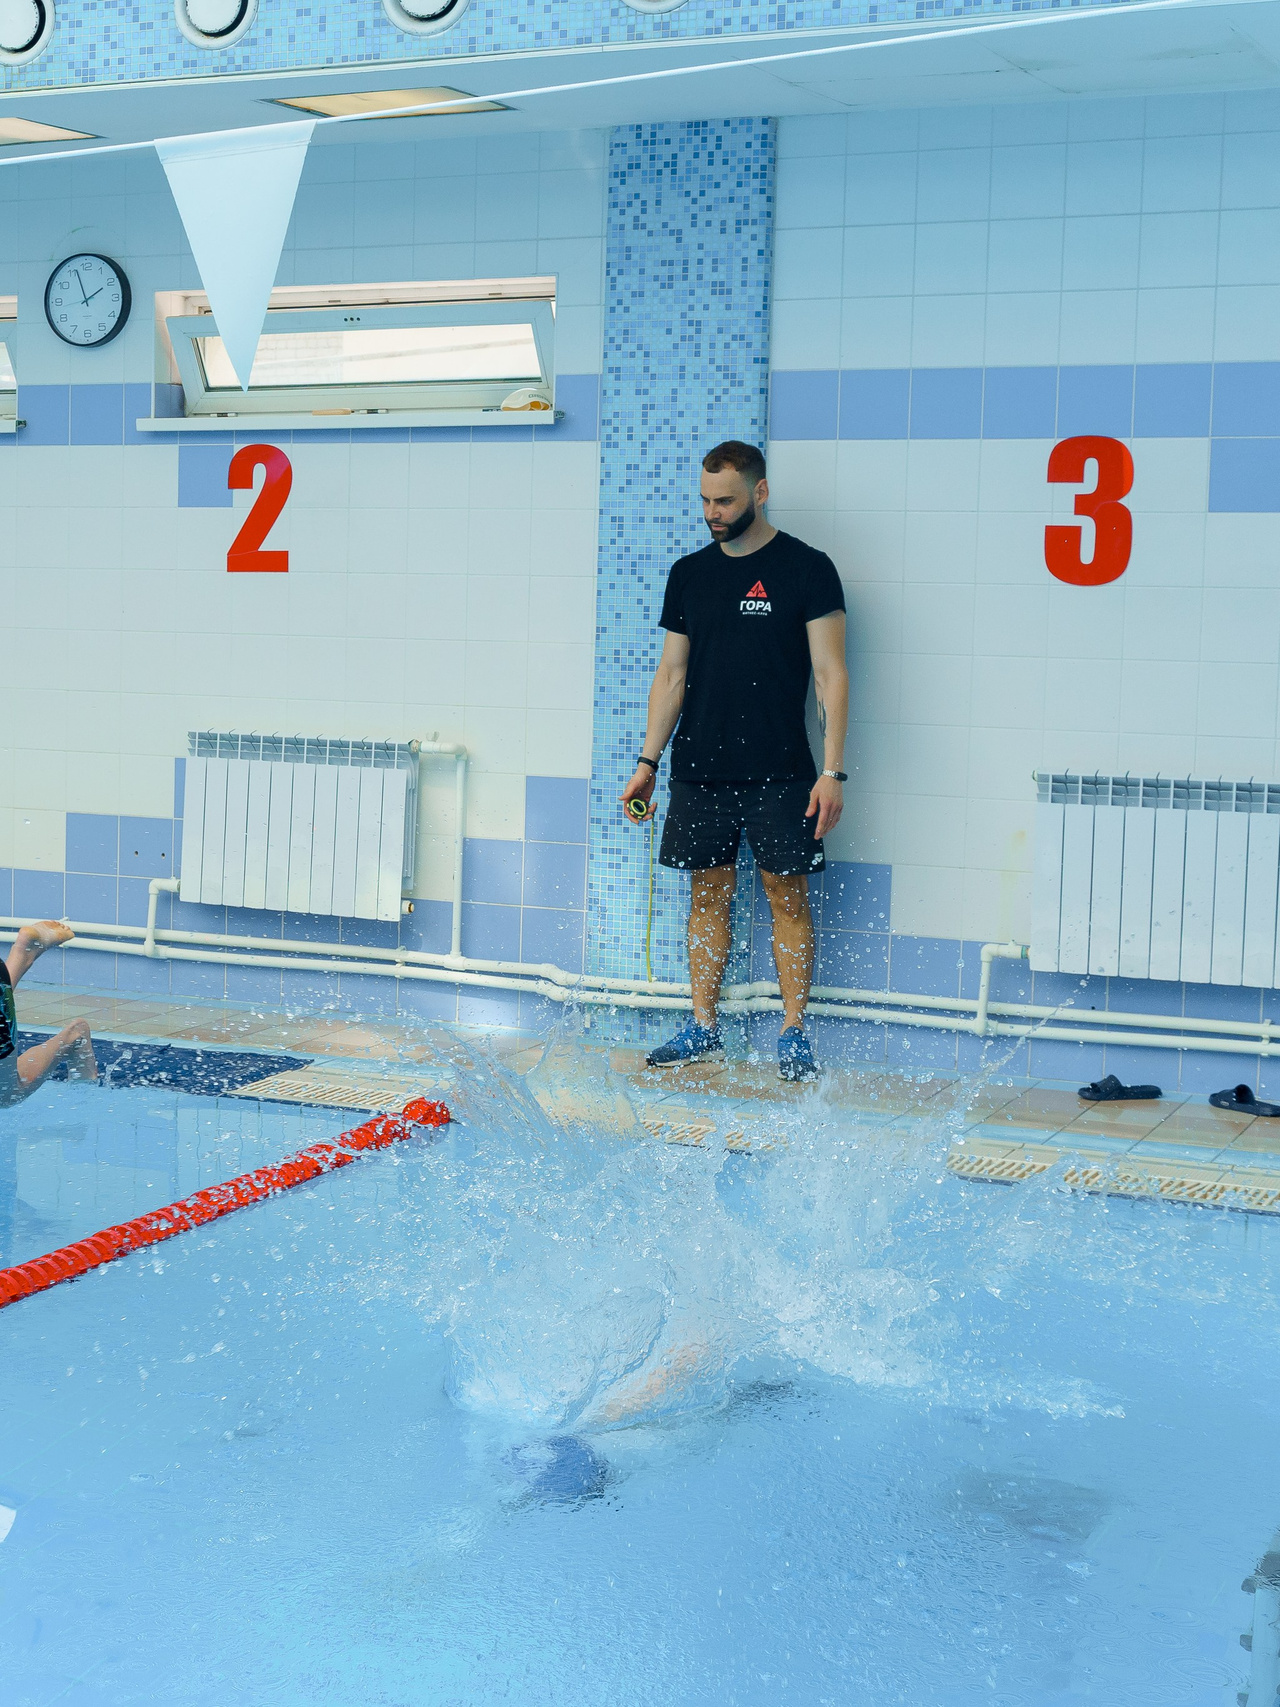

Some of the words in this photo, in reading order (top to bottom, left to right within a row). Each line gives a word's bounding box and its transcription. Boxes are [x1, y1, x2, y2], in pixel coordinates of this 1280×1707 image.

[80, 262, 92, 271] 12
[67, 269, 77, 277] 11
[58, 281, 69, 290] 10
[106, 277, 115, 286] 2
[54, 297, 63, 306] 9
[111, 293, 120, 302] 3
[59, 313, 68, 322] 8
[107, 310, 116, 318] 4
[70, 324, 78, 334] 7
[98, 322, 107, 331] 5
[83, 329, 92, 338] 6
[227, 443, 293, 572] 2
[1044, 434, 1134, 586] 3
[739, 600, 772, 612] ГОРА
